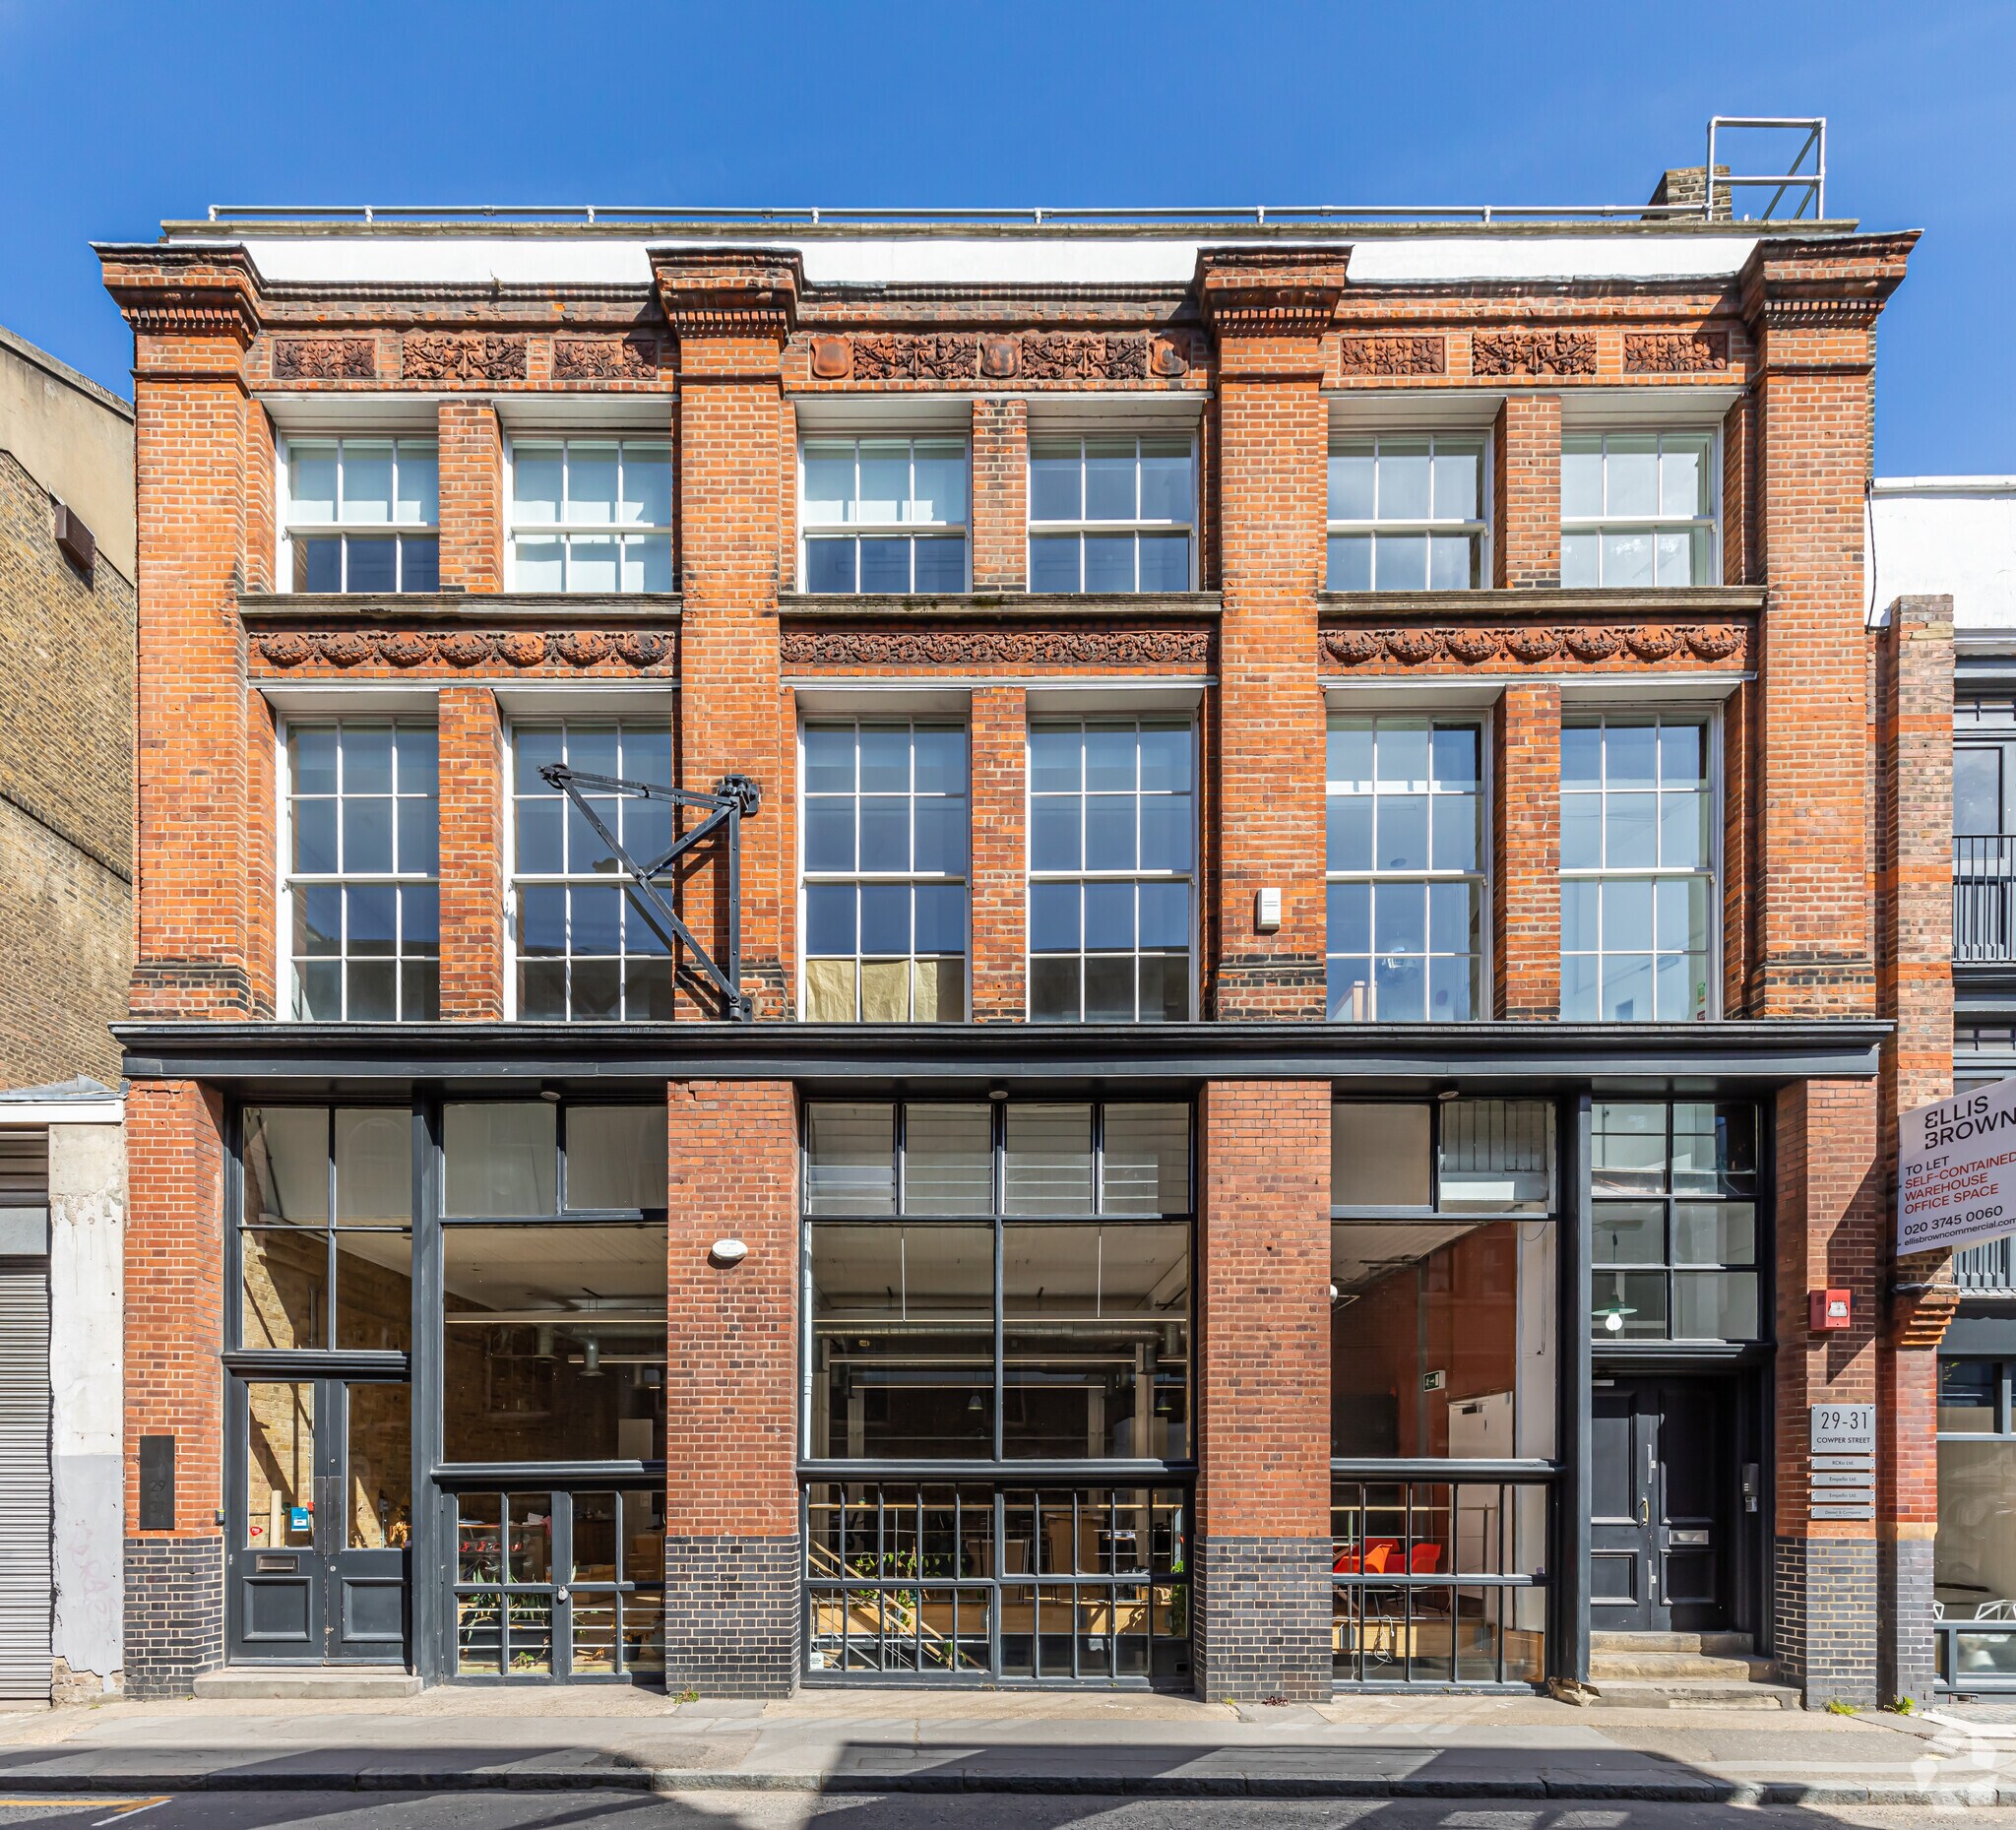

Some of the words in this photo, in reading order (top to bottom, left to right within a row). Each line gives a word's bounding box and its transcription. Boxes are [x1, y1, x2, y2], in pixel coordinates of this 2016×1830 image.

[1924, 1096, 1988, 1129] ELLIS
[1924, 1107, 2016, 1150] BROWN
[1905, 1152, 2016, 1189] SELF-CONTAINED
[1906, 1164, 1922, 1175] TO
[1926, 1156, 1949, 1170] LET
[1904, 1195, 1949, 1215] OFFICE
[1954, 1183, 1998, 1203] SPACE
[1905, 1172, 1987, 1202] WAREHOUSE
[1904, 1222, 1927, 1235] 020
[1931, 1214, 1962, 1230] 3745
[1966, 1205, 2003, 1223] 0060
[1821, 1412, 1866, 1429] 29-31
[150, 1480, 166, 1492] 29
